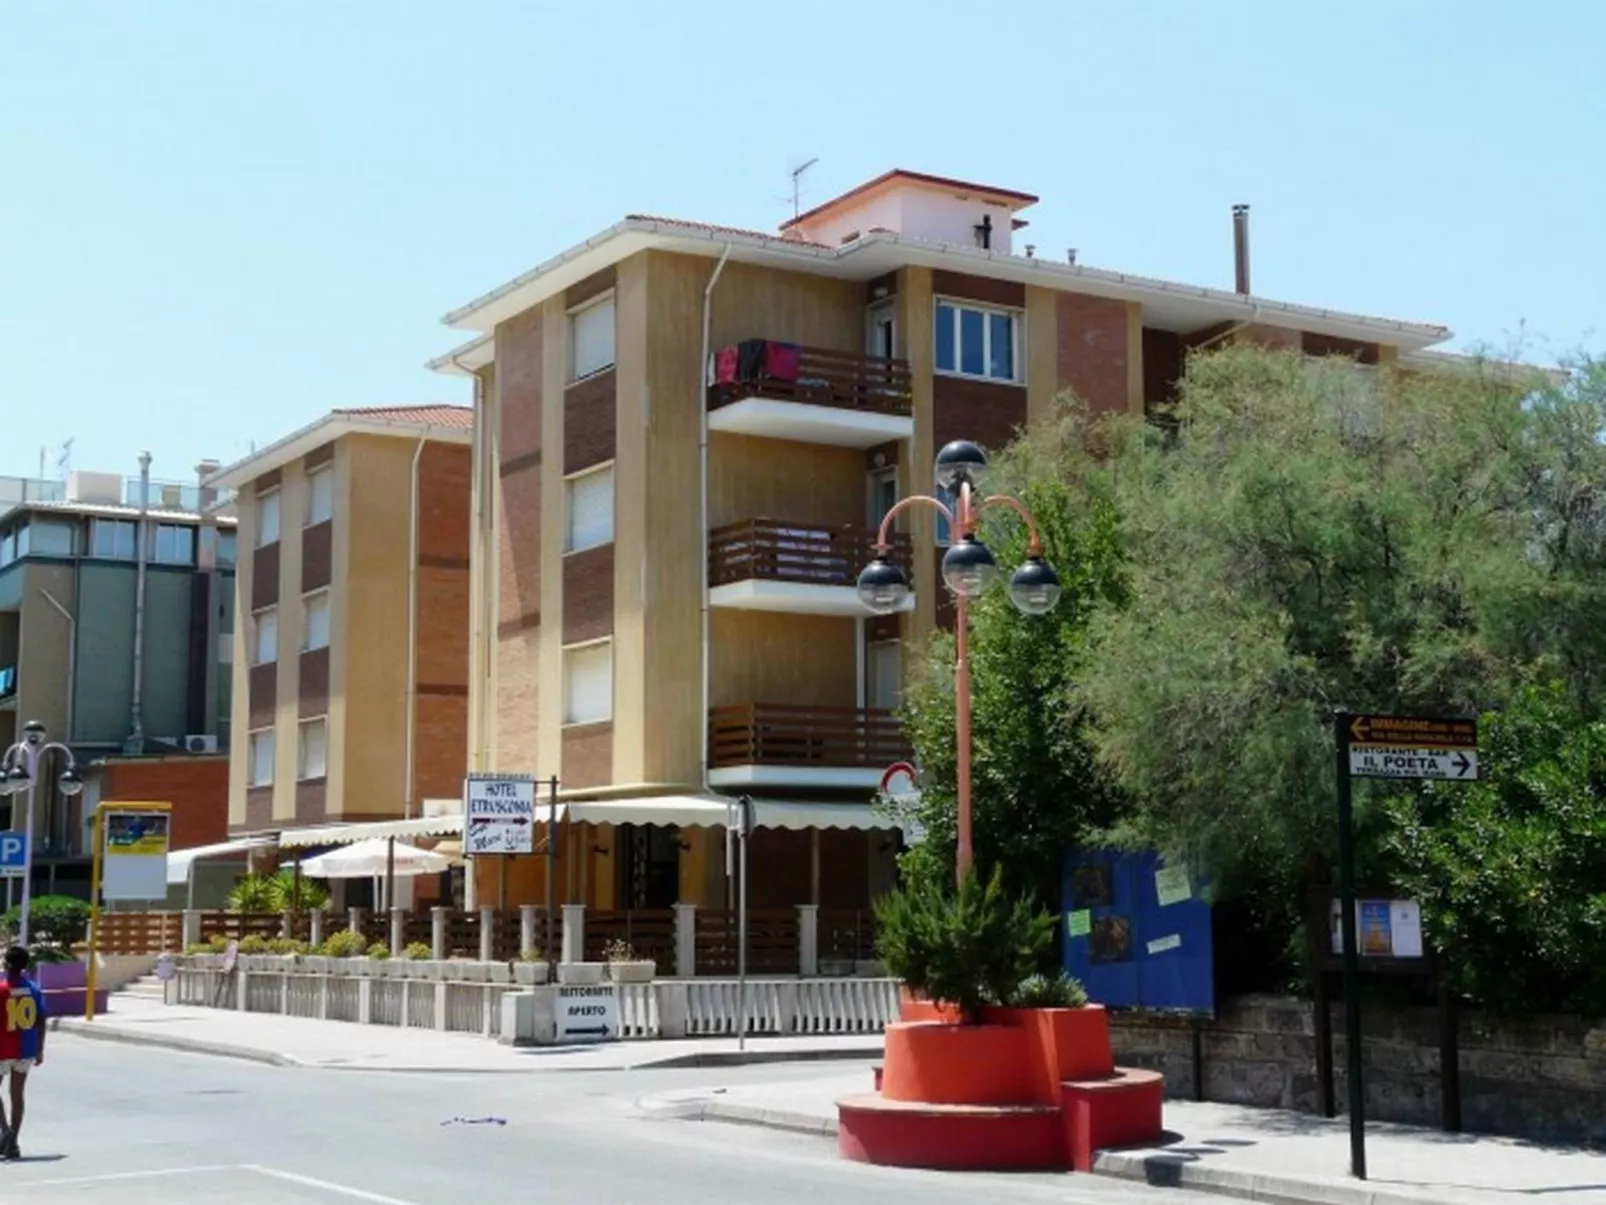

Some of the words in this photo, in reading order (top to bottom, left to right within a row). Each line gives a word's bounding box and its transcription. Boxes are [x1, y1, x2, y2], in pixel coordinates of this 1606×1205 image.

[1352, 745, 1418, 756] RISTORANTE
[1364, 755, 1378, 768] IL
[1384, 756, 1439, 769] POETA
[485, 783, 516, 797] HOTEL
[2, 838, 21, 861] P
[6, 996, 37, 1031] 10
[567, 1005, 607, 1016] APERTO
